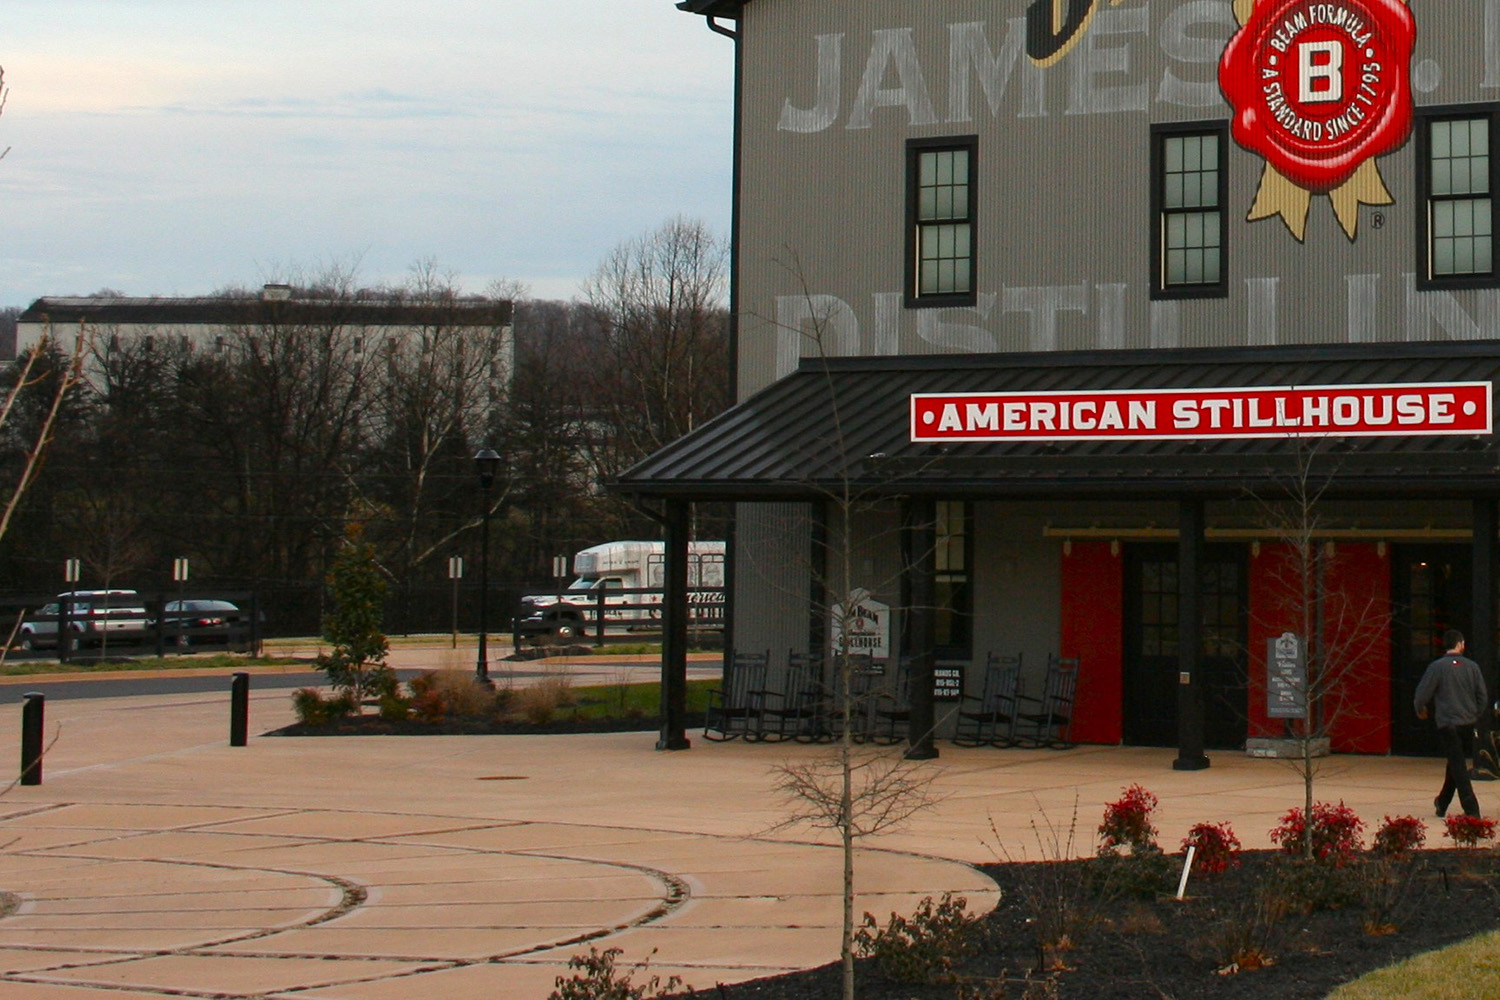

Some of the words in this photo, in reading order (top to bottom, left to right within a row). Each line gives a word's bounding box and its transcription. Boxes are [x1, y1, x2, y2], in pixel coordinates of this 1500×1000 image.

[1270, 11, 1308, 53] BEAM
[1308, 4, 1372, 49] FORMULA
[777, 0, 1238, 134] JAMES
[1262, 67, 1279, 79] A
[1298, 40, 1344, 105] B
[1356, 62, 1381, 106] 1795
[1263, 81, 1322, 141] STANDARD
[1325, 102, 1365, 140] SINCE
[937, 400, 1157, 432] AMERICAN
[1172, 393, 1457, 429] STILLHOUSE
